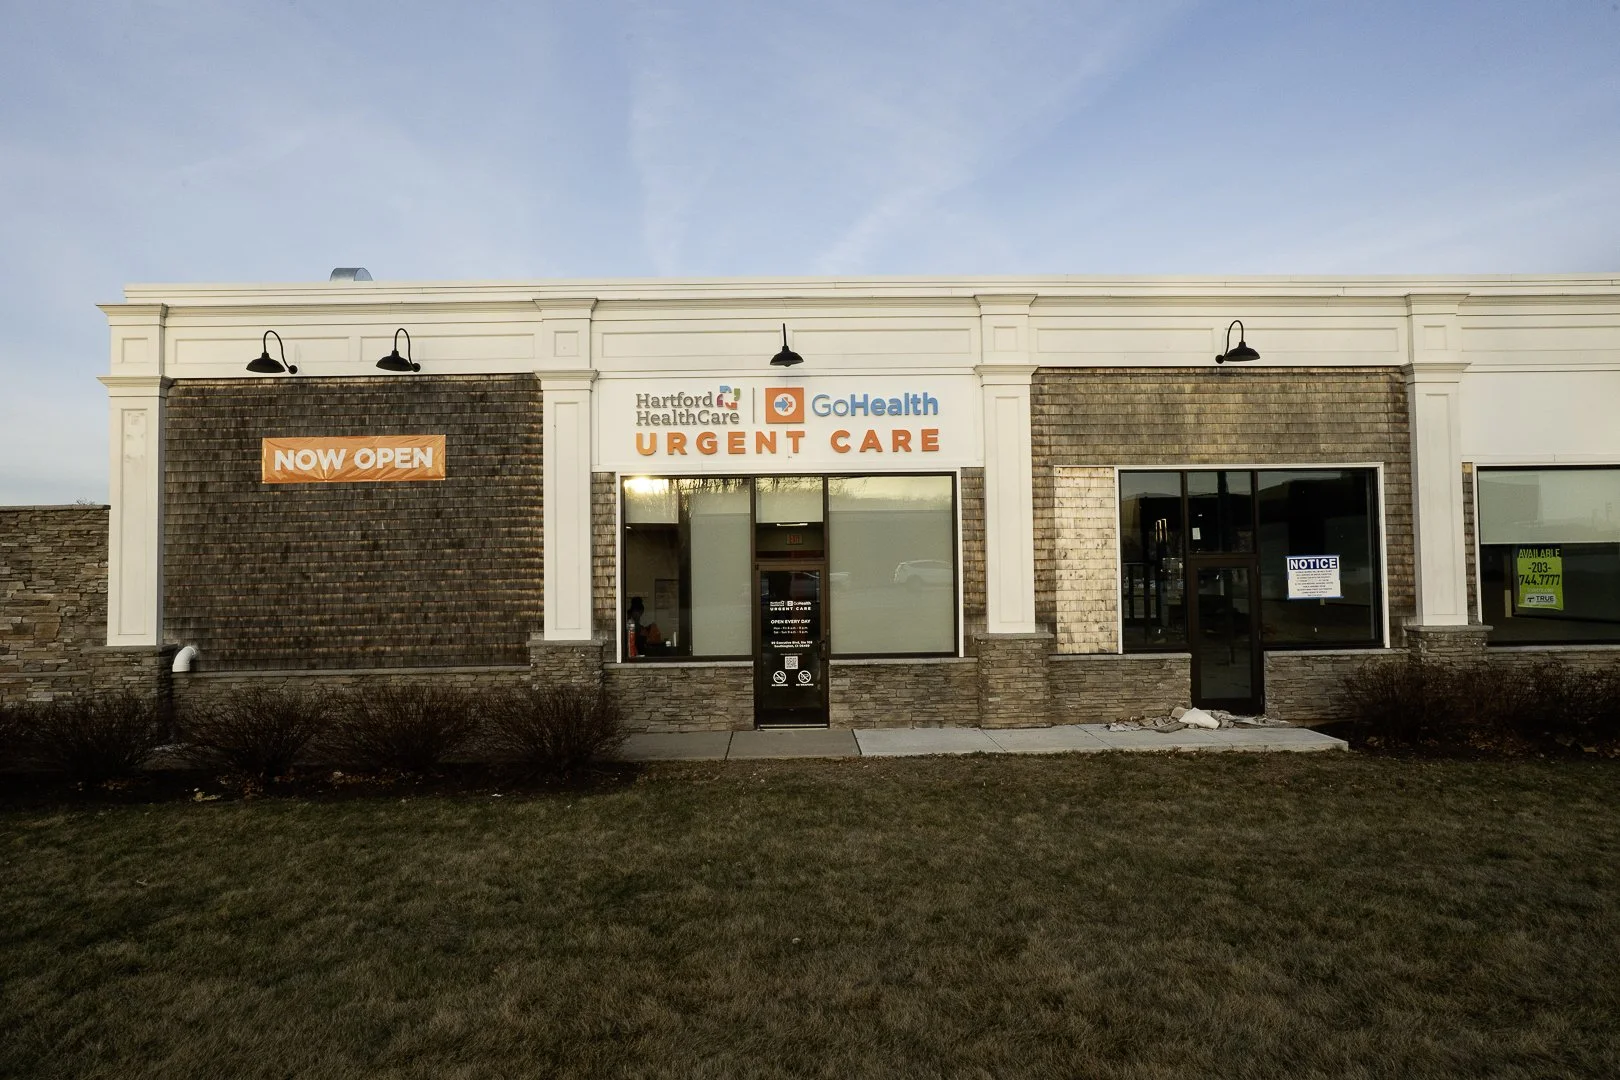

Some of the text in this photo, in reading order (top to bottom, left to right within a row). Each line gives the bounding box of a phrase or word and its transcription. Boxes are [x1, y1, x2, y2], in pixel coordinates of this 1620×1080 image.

[636, 391, 714, 408] Hartford
[812, 392, 939, 417] GoHealth
[636, 409, 740, 426] HealthCare
[635, 428, 940, 457] URGENT CARE
[274, 446, 433, 471] NOW OPEN
[1519, 548, 1560, 558] AVAILABLE
[1290, 558, 1337, 570] NOTICE
[1519, 574, 1560, 586] 744.7777
